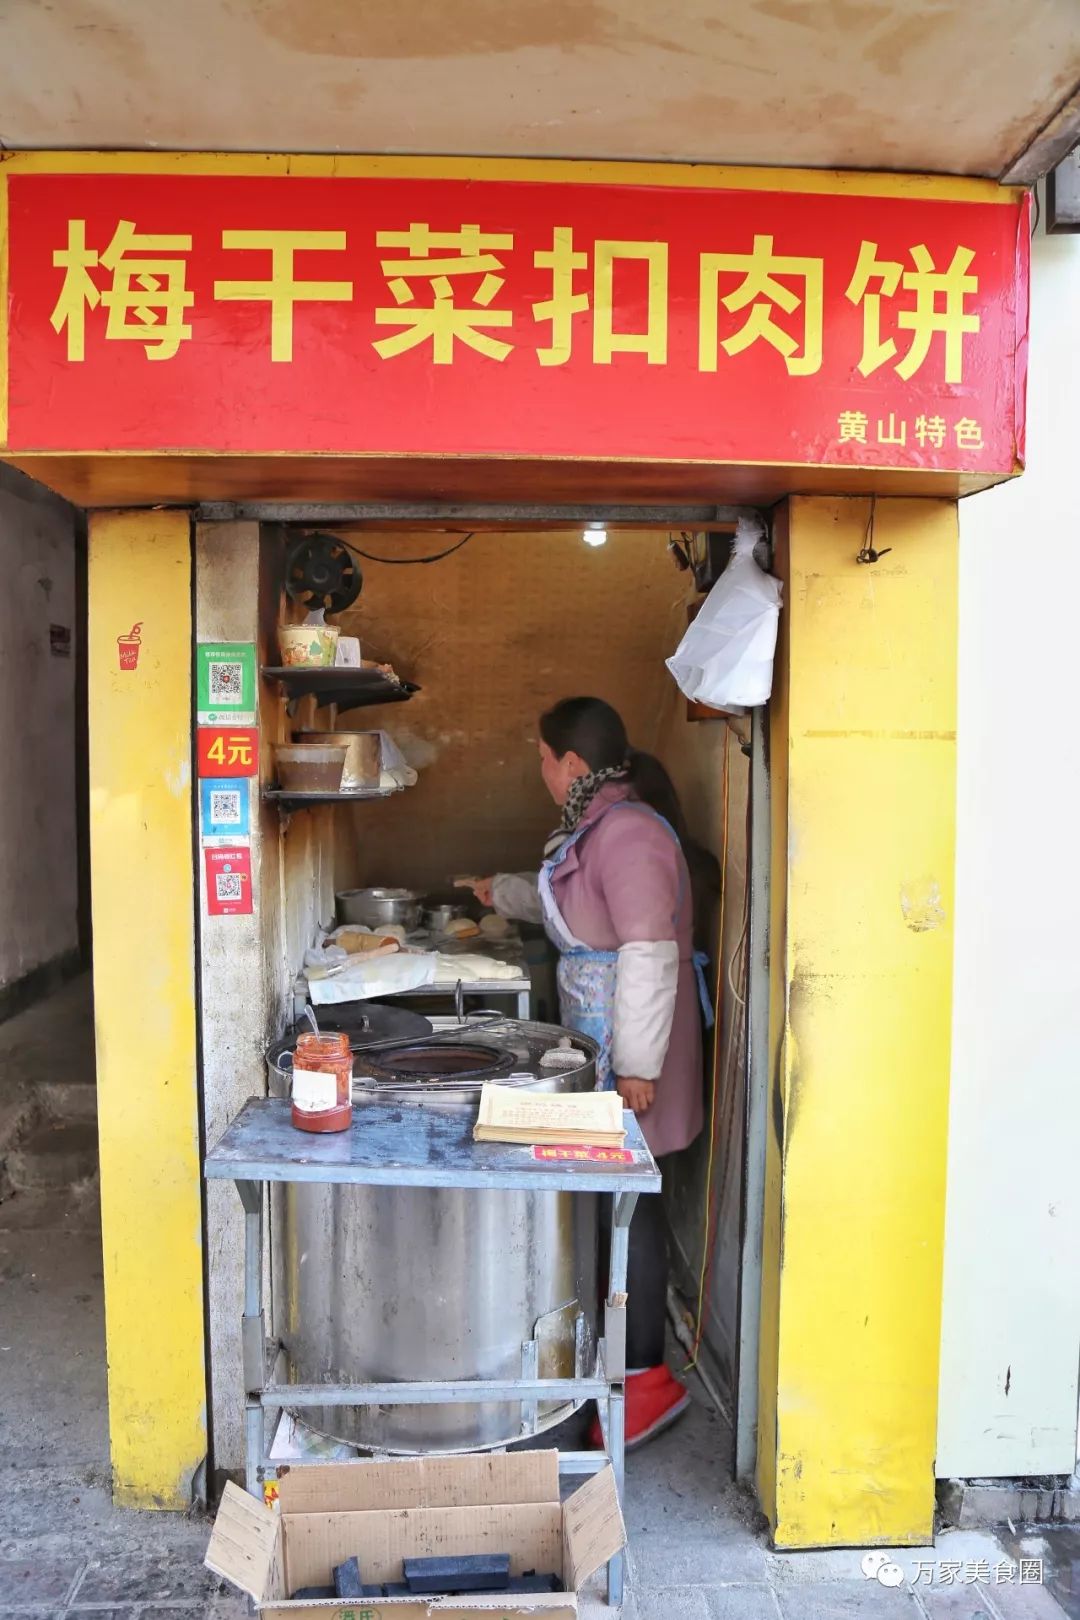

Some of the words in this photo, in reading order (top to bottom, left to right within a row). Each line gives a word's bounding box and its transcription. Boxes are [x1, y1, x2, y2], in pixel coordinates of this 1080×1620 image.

[50, 220, 981, 383] 梅干菜扣肉饼
[837, 410, 984, 449] 黄山特色
[207, 736, 252, 765] 4元
